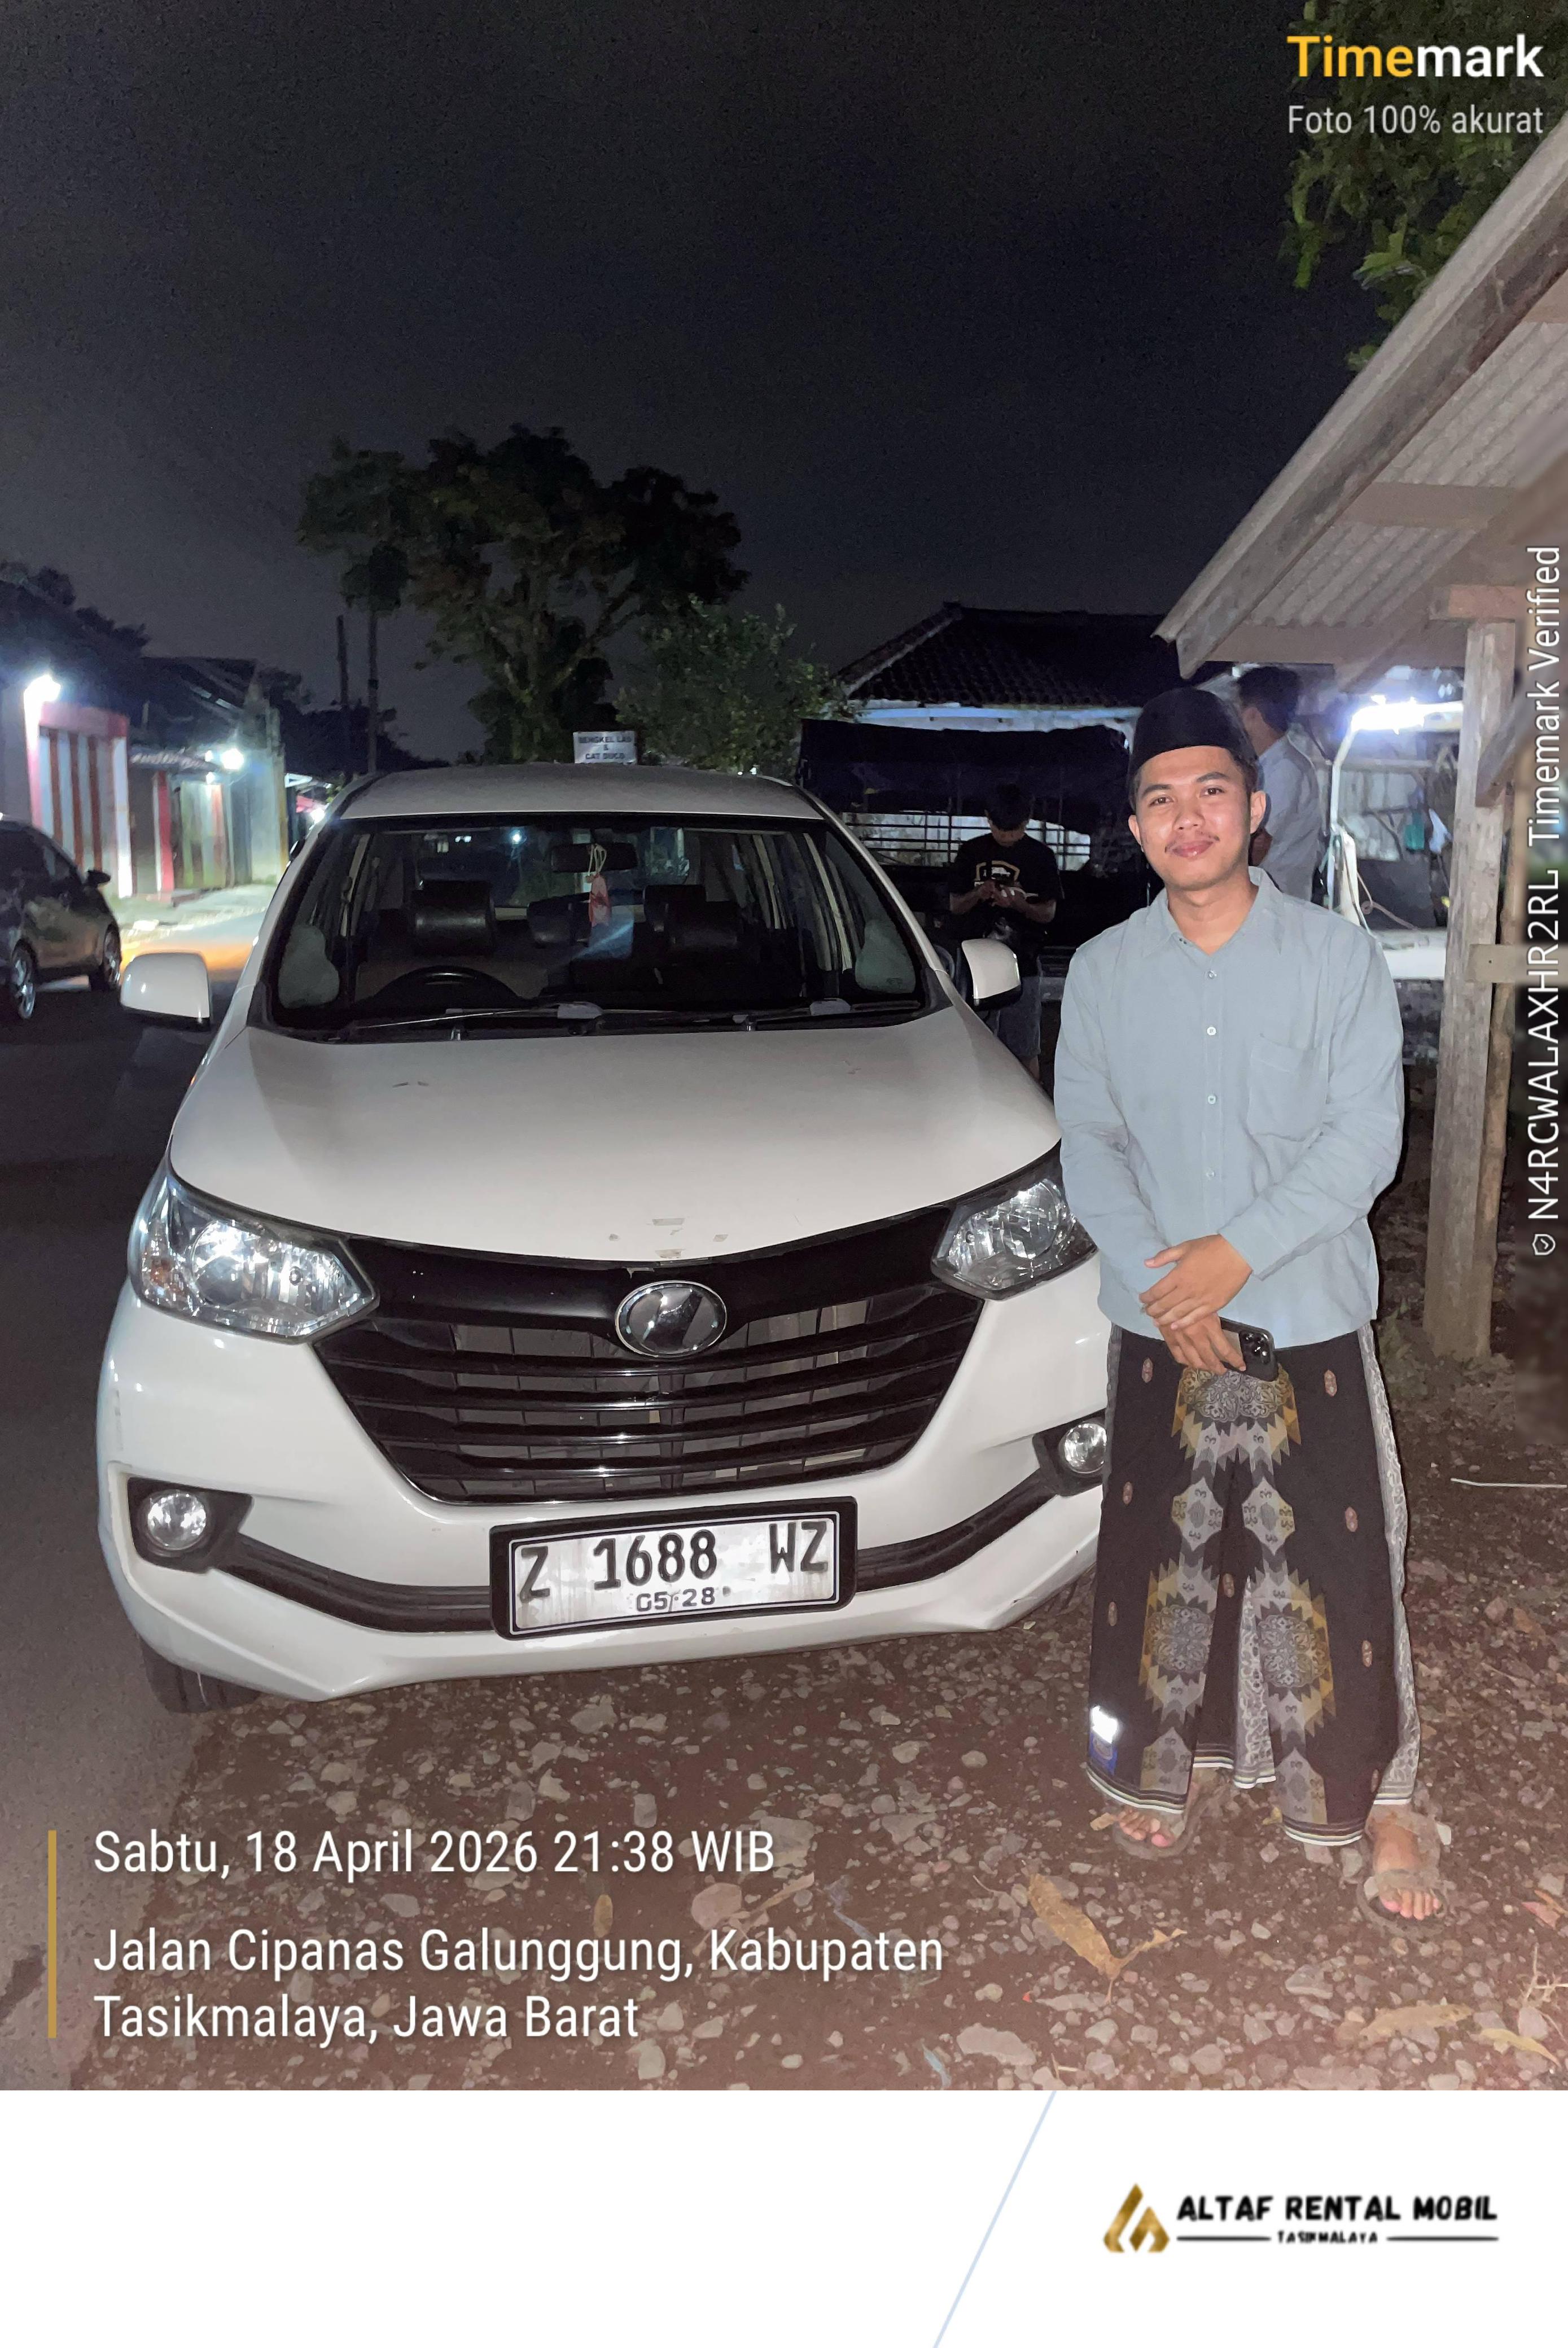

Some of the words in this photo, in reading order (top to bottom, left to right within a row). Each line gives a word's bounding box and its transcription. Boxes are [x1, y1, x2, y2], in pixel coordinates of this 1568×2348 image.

[520, 1546, 551, 1600] Z
[593, 1529, 718, 1590] 1688
[769, 1521, 829, 1574] WZ
